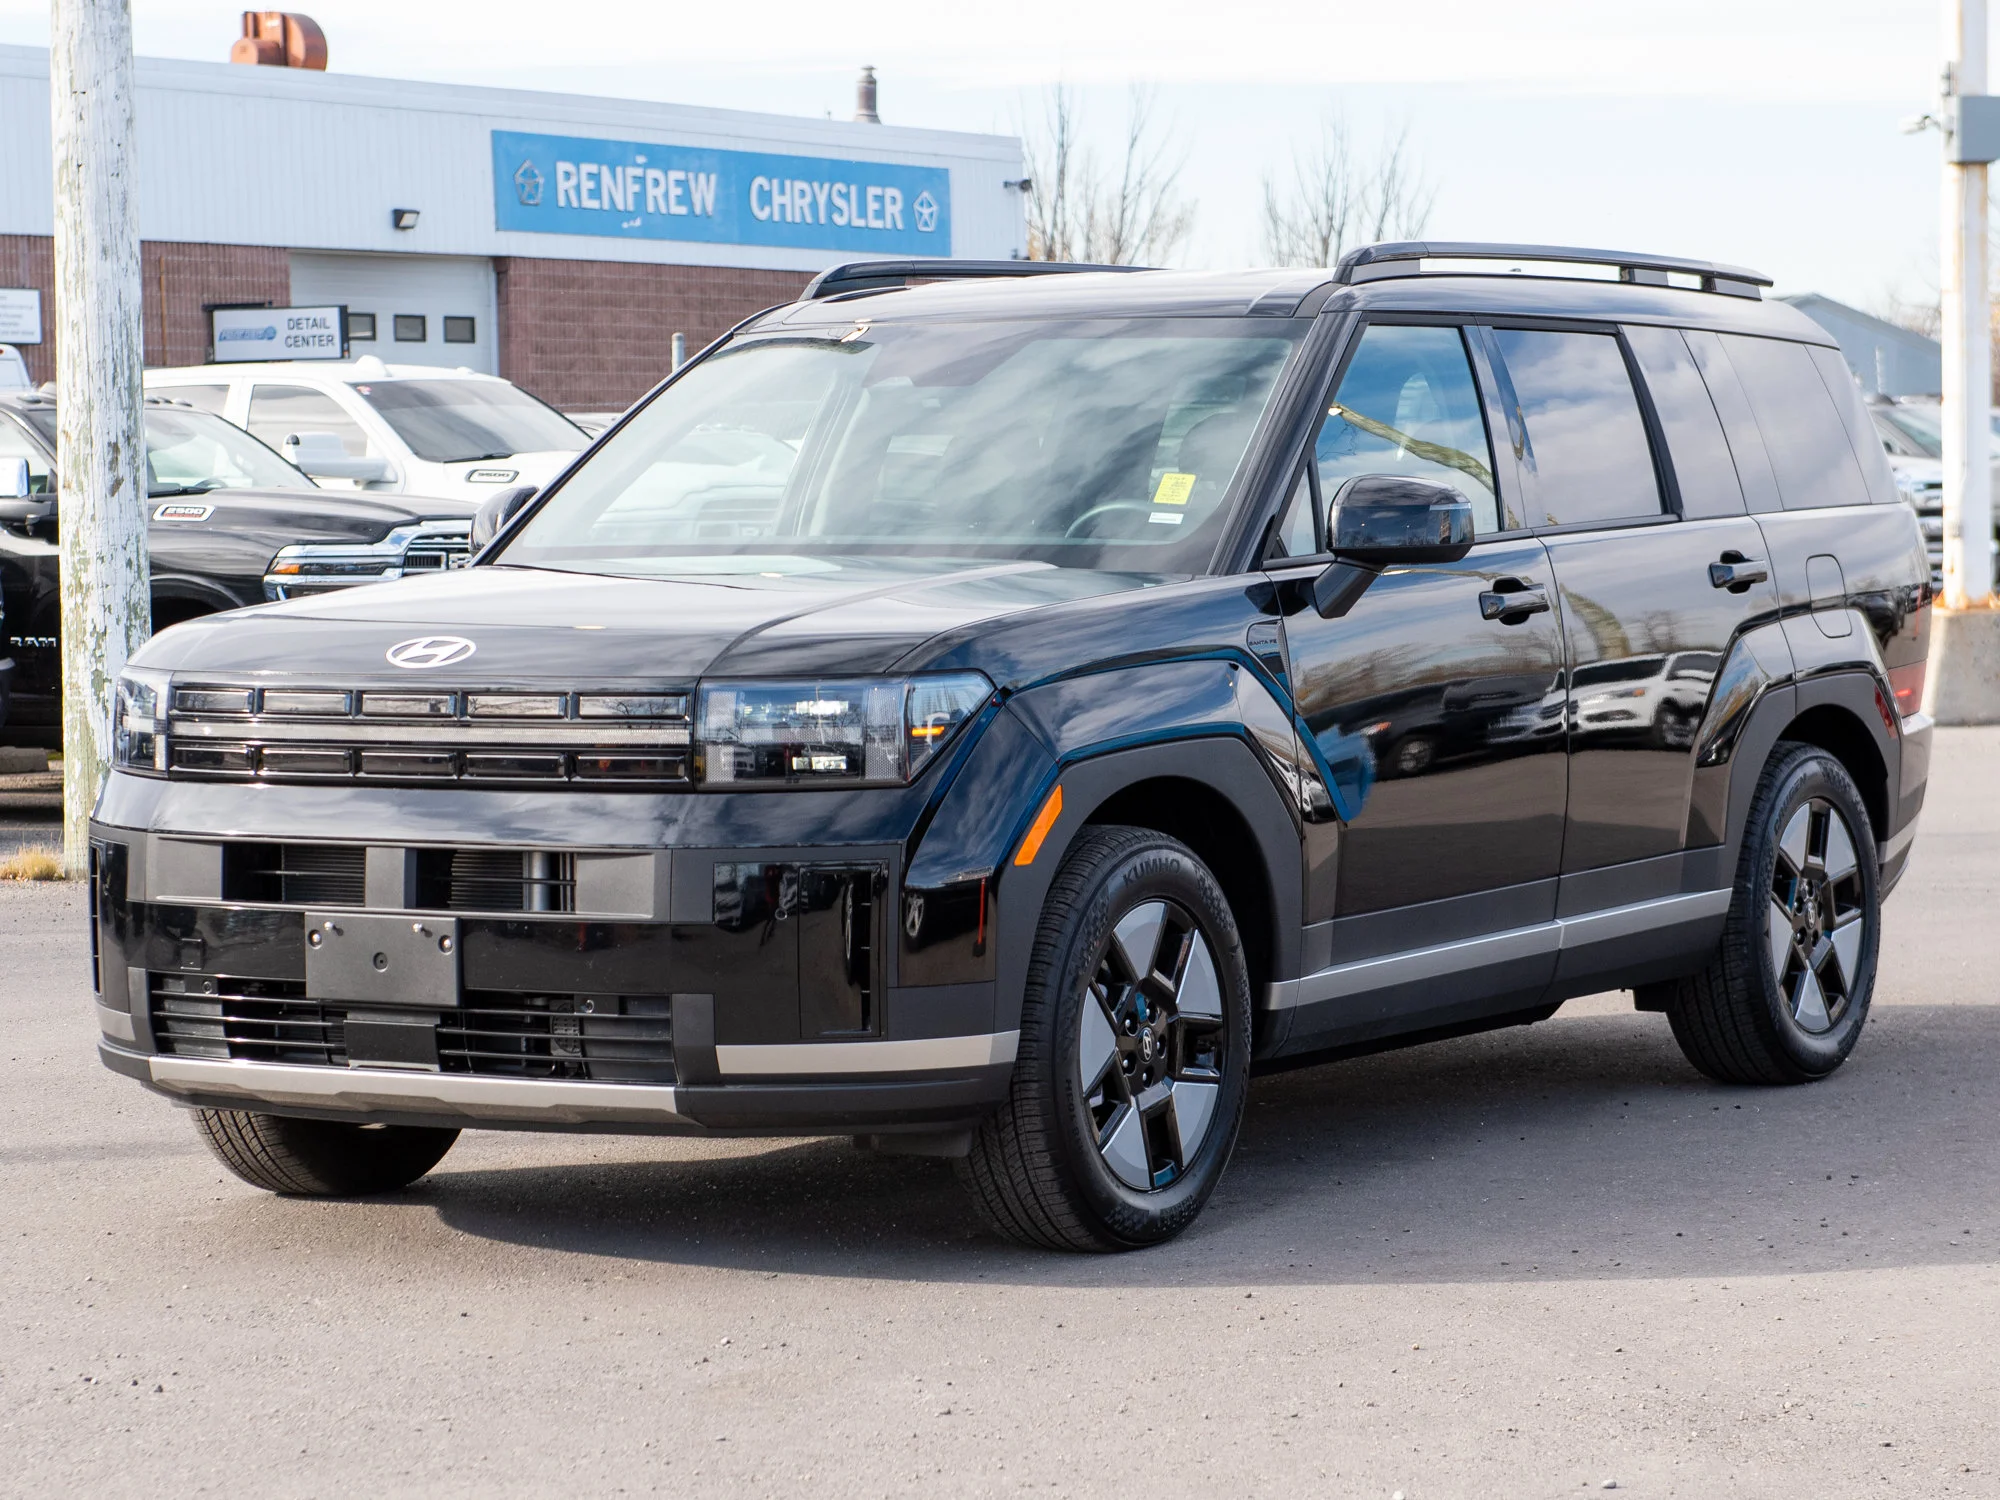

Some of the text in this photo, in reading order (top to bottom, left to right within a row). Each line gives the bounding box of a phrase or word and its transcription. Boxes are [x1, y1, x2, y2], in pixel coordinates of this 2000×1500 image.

[555, 160, 904, 231] RENFREW CHRYSLER
[287, 317, 331, 331] DETAIL
[284, 334, 335, 348] CENTER
[164, 507, 206, 515] 2500
[10, 636, 57, 648] RAM
[1123, 858, 1181, 888] KUMHO
